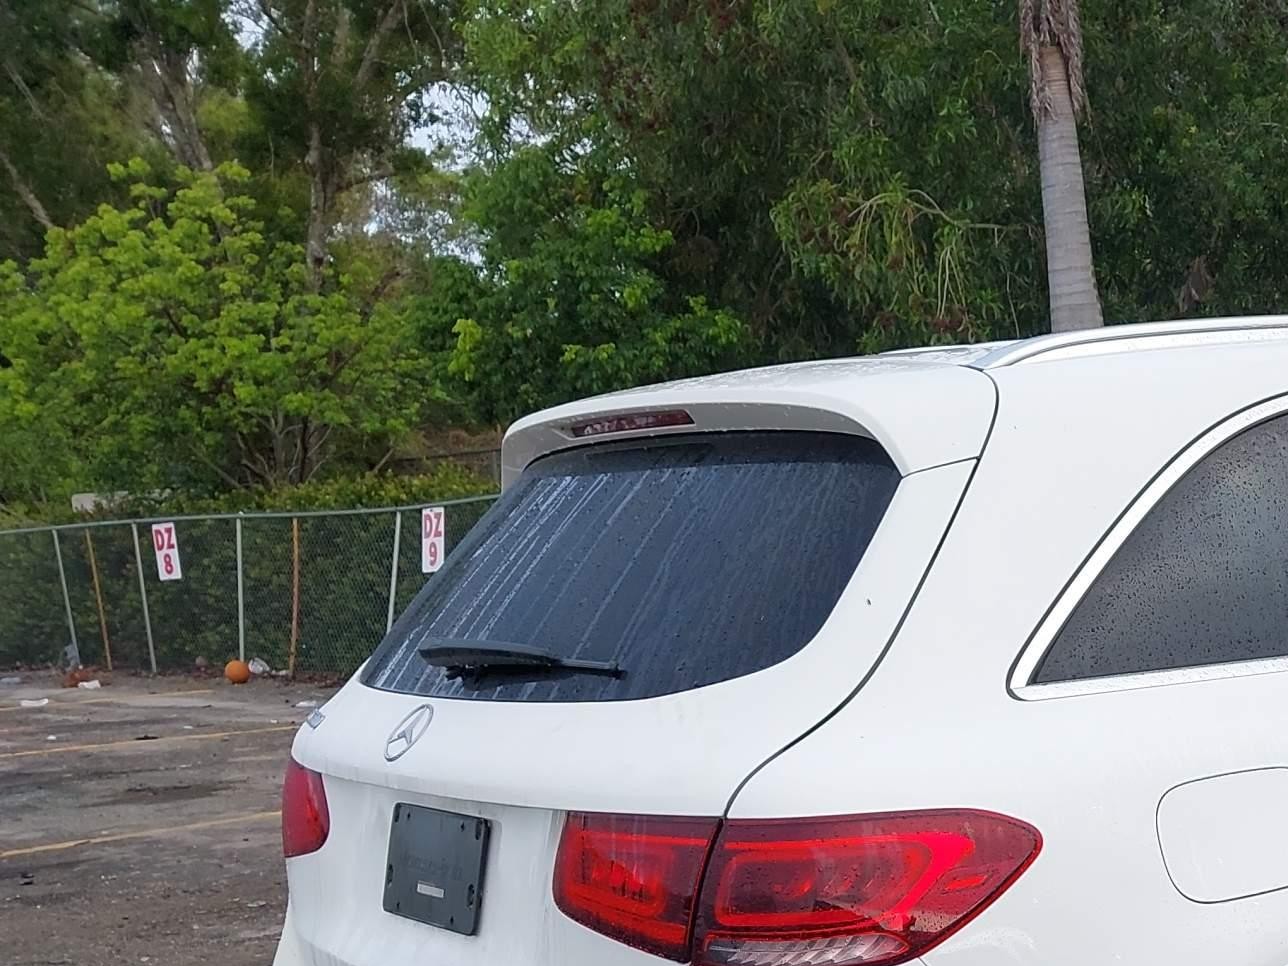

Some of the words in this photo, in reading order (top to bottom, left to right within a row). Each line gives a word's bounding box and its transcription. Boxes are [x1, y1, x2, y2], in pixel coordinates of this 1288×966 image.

[424, 512, 442, 539] DZ
[154, 527, 175, 551] DZ
[163, 553, 174, 575] 8
[429, 541, 438, 567] 9
